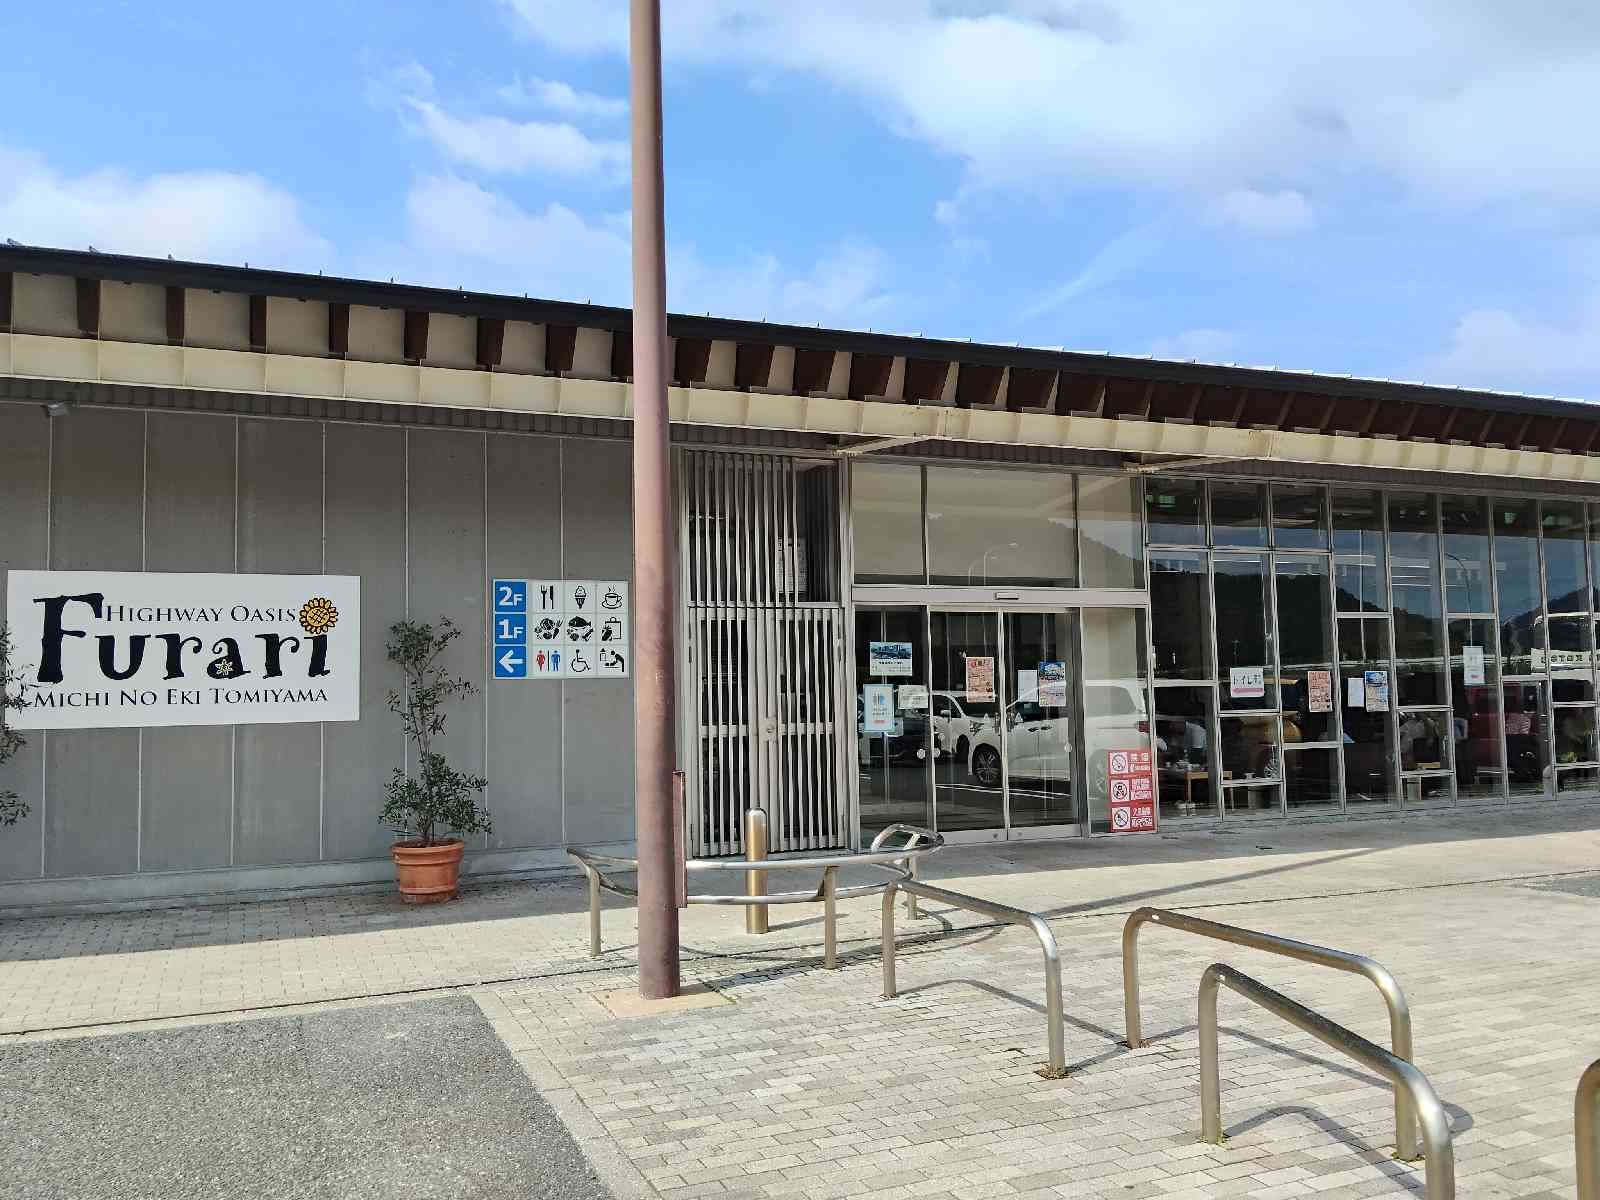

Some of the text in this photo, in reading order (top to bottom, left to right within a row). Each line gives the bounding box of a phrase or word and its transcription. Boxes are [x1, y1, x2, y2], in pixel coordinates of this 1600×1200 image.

[498, 586, 523, 606] 2F
[106, 605, 296, 623] HIGHWAY OASIS
[498, 618, 524, 639] 1F
[32, 592, 332, 687] Furari
[34, 687, 328, 708] MICHI NO EKI TOMIYAMA
